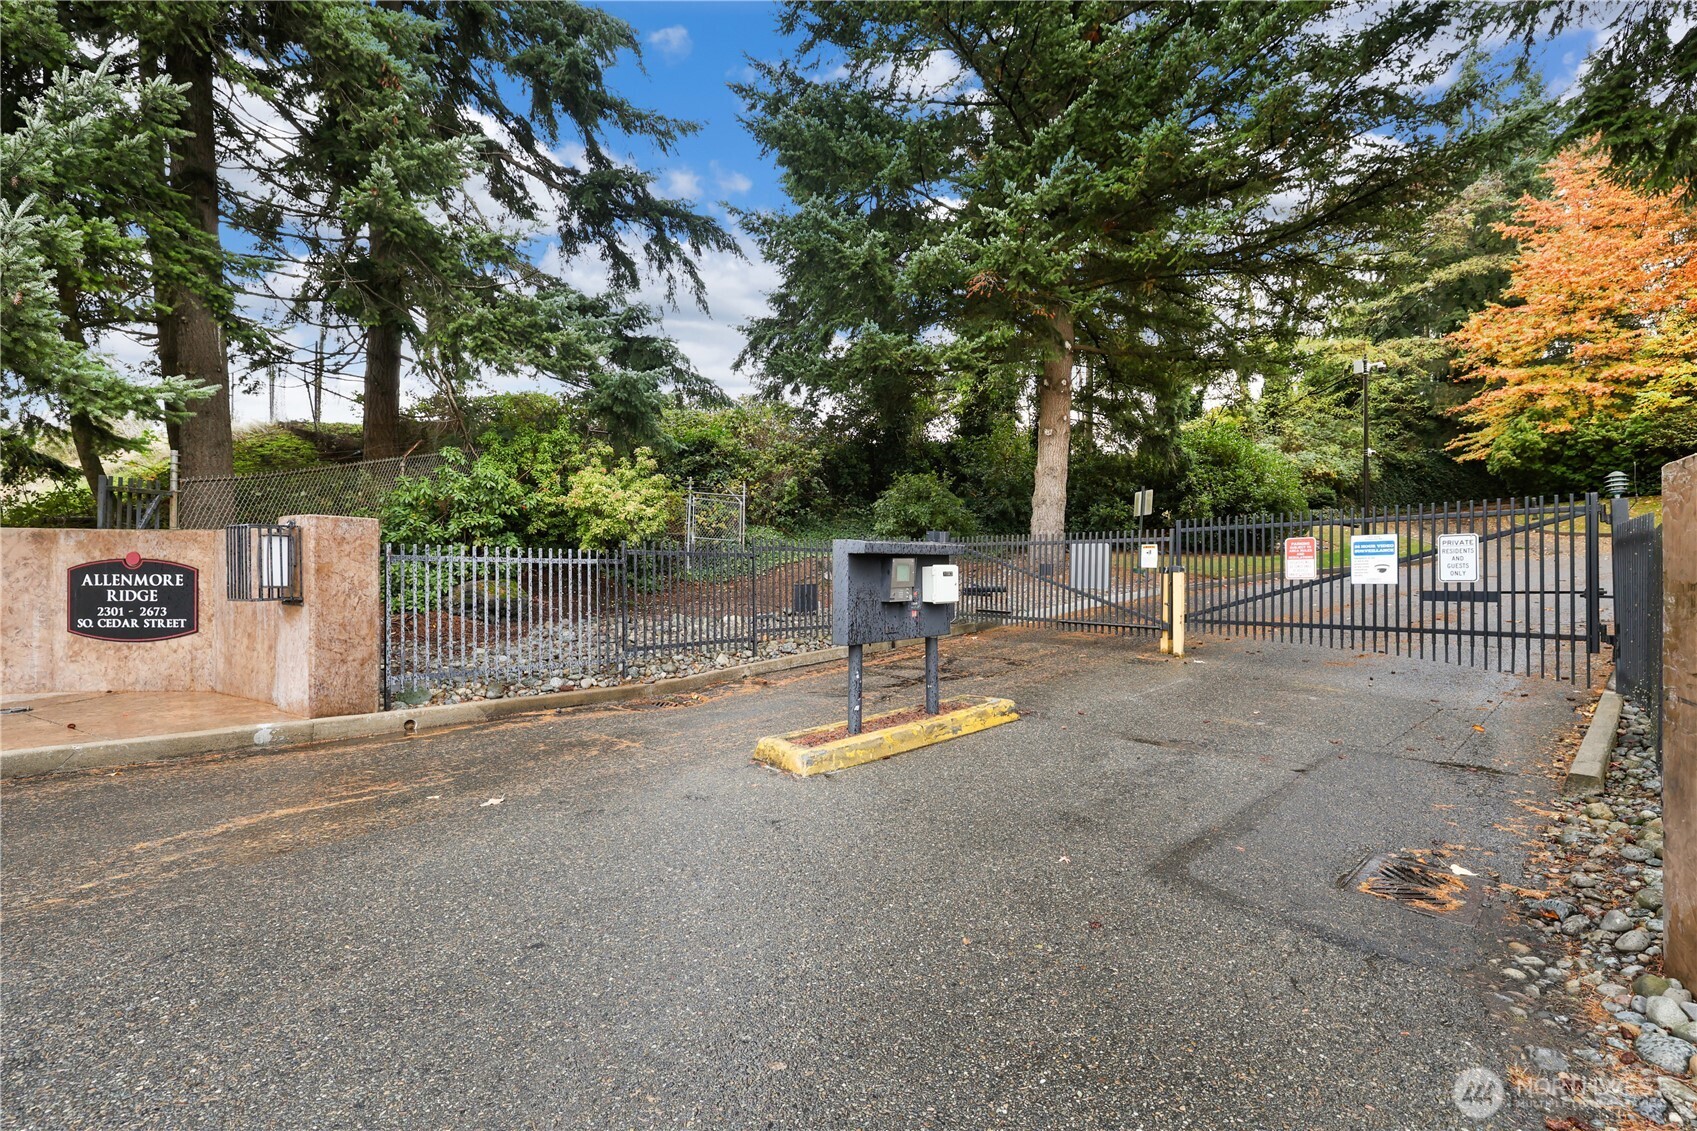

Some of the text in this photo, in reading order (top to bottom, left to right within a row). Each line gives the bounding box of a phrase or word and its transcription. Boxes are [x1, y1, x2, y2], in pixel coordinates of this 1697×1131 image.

[81, 574, 184, 586] ALLENMORE
[106, 589, 158, 602] RIDGE
[97, 607, 124, 616] 2301
[140, 607, 168, 616] 2673
[77, 619, 187, 628] SO. CEDAR STREET
